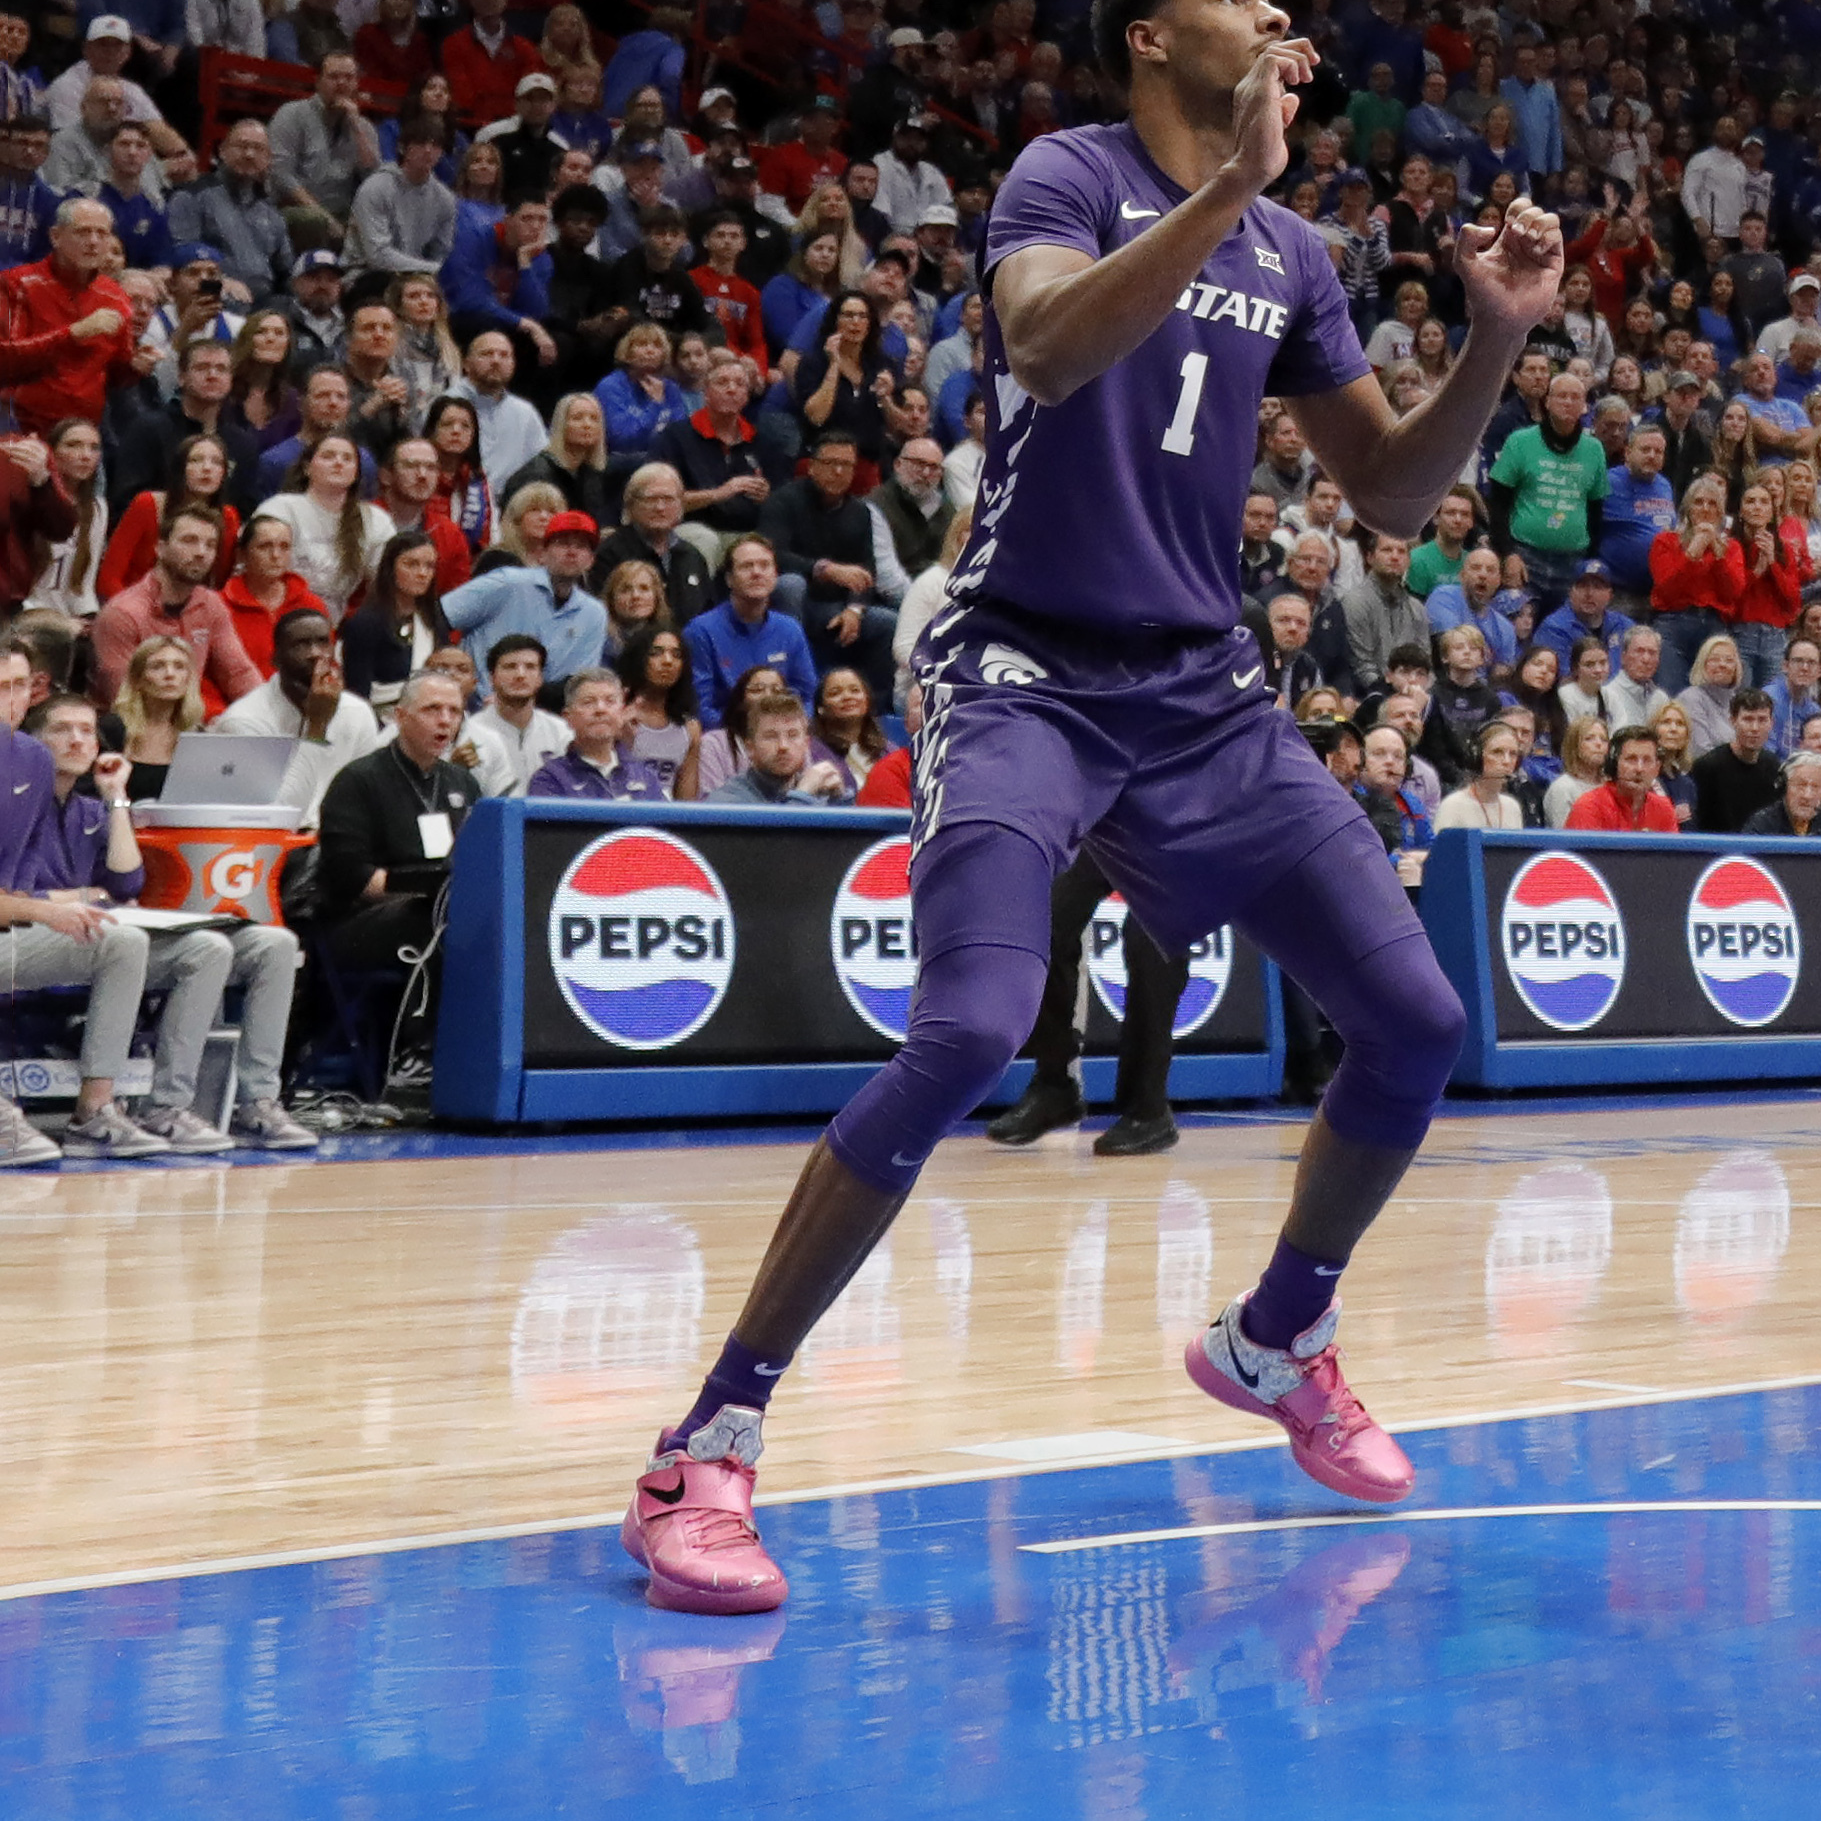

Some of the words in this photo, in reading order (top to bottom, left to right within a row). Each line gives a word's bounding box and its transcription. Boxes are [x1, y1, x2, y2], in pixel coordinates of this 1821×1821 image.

[1161, 352, 1209, 456] 1
[209, 851, 256, 899] G
[561, 915, 724, 961] PEPSI
[1510, 922, 1620, 959] PEPSI
[1693, 922, 1796, 959] PEPSI
